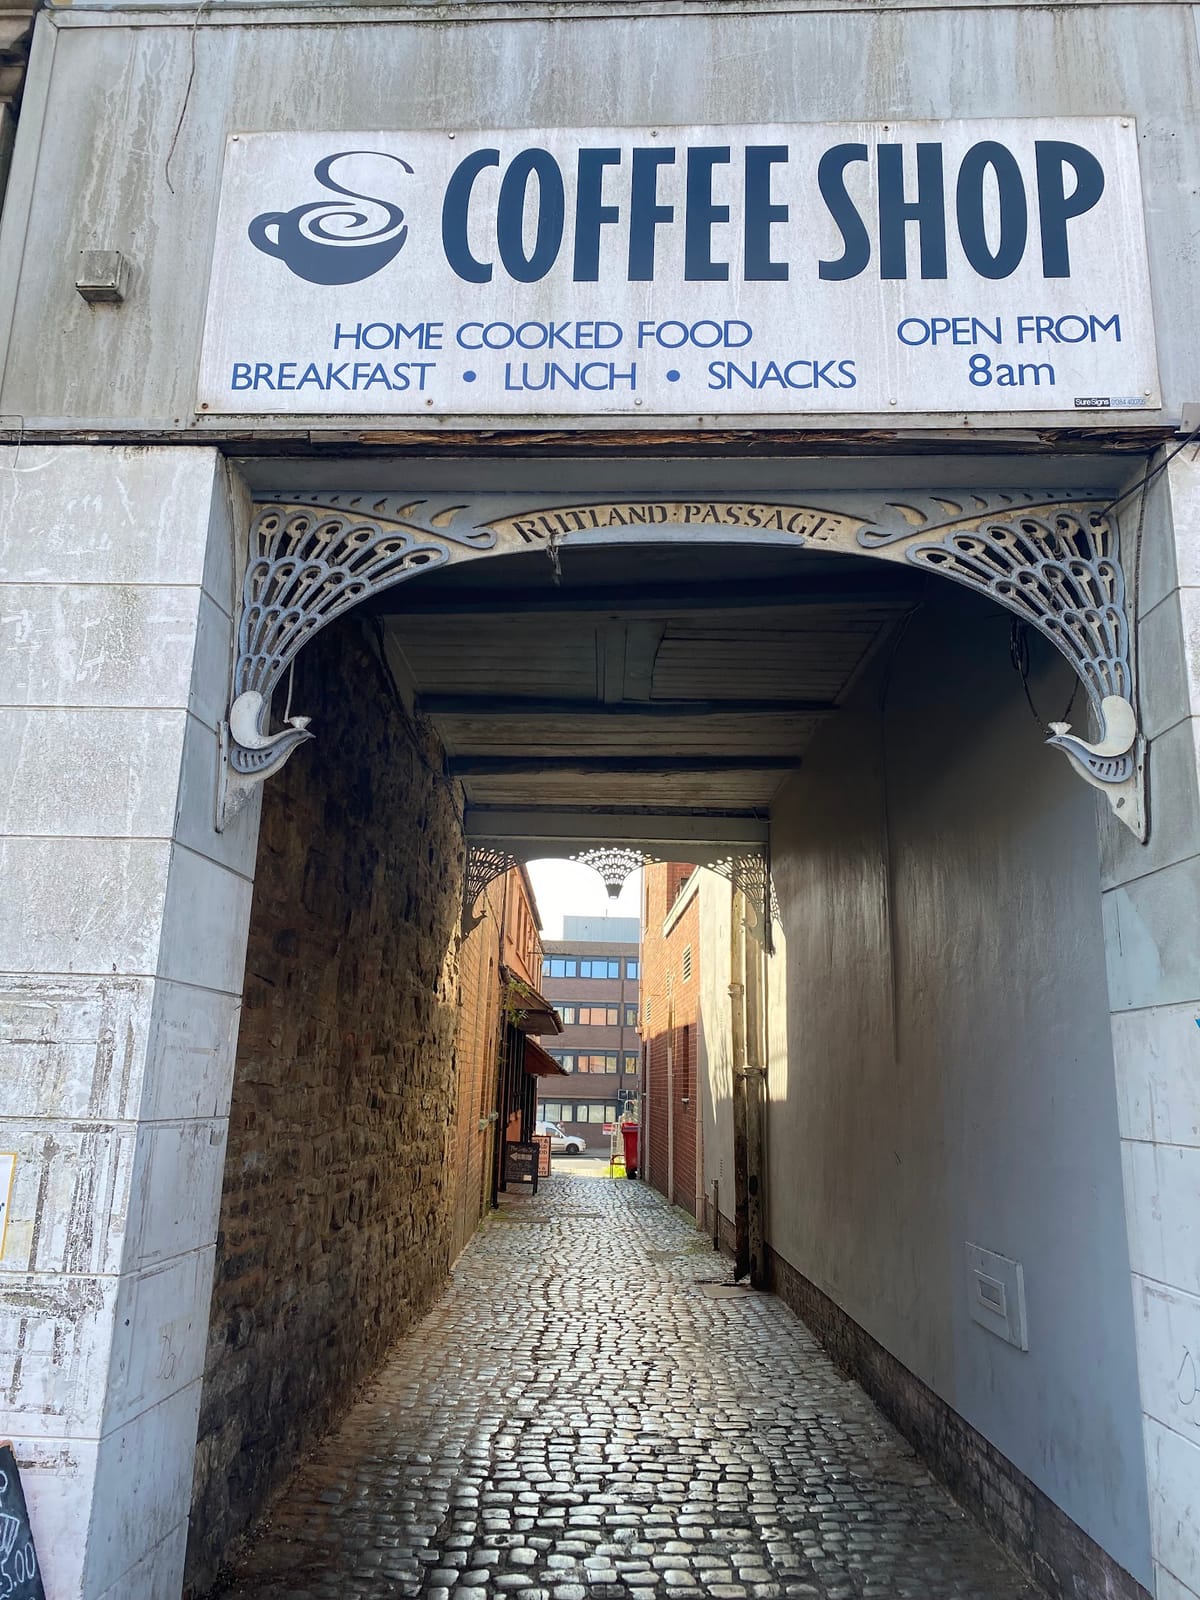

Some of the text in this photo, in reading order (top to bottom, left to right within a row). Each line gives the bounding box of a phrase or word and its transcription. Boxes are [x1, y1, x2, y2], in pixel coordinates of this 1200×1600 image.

[442, 140, 1105, 283] COFFEE SHOP
[333, 320, 753, 350] HOME COOKED FOOD
[897, 314, 1122, 346] OPEN FROM
[231, 360, 857, 390] BREAKFAST LUNCH SNACKS
[968, 353, 1056, 387] 8am
[512, 504, 842, 543] RUTLAND PASSAGE
